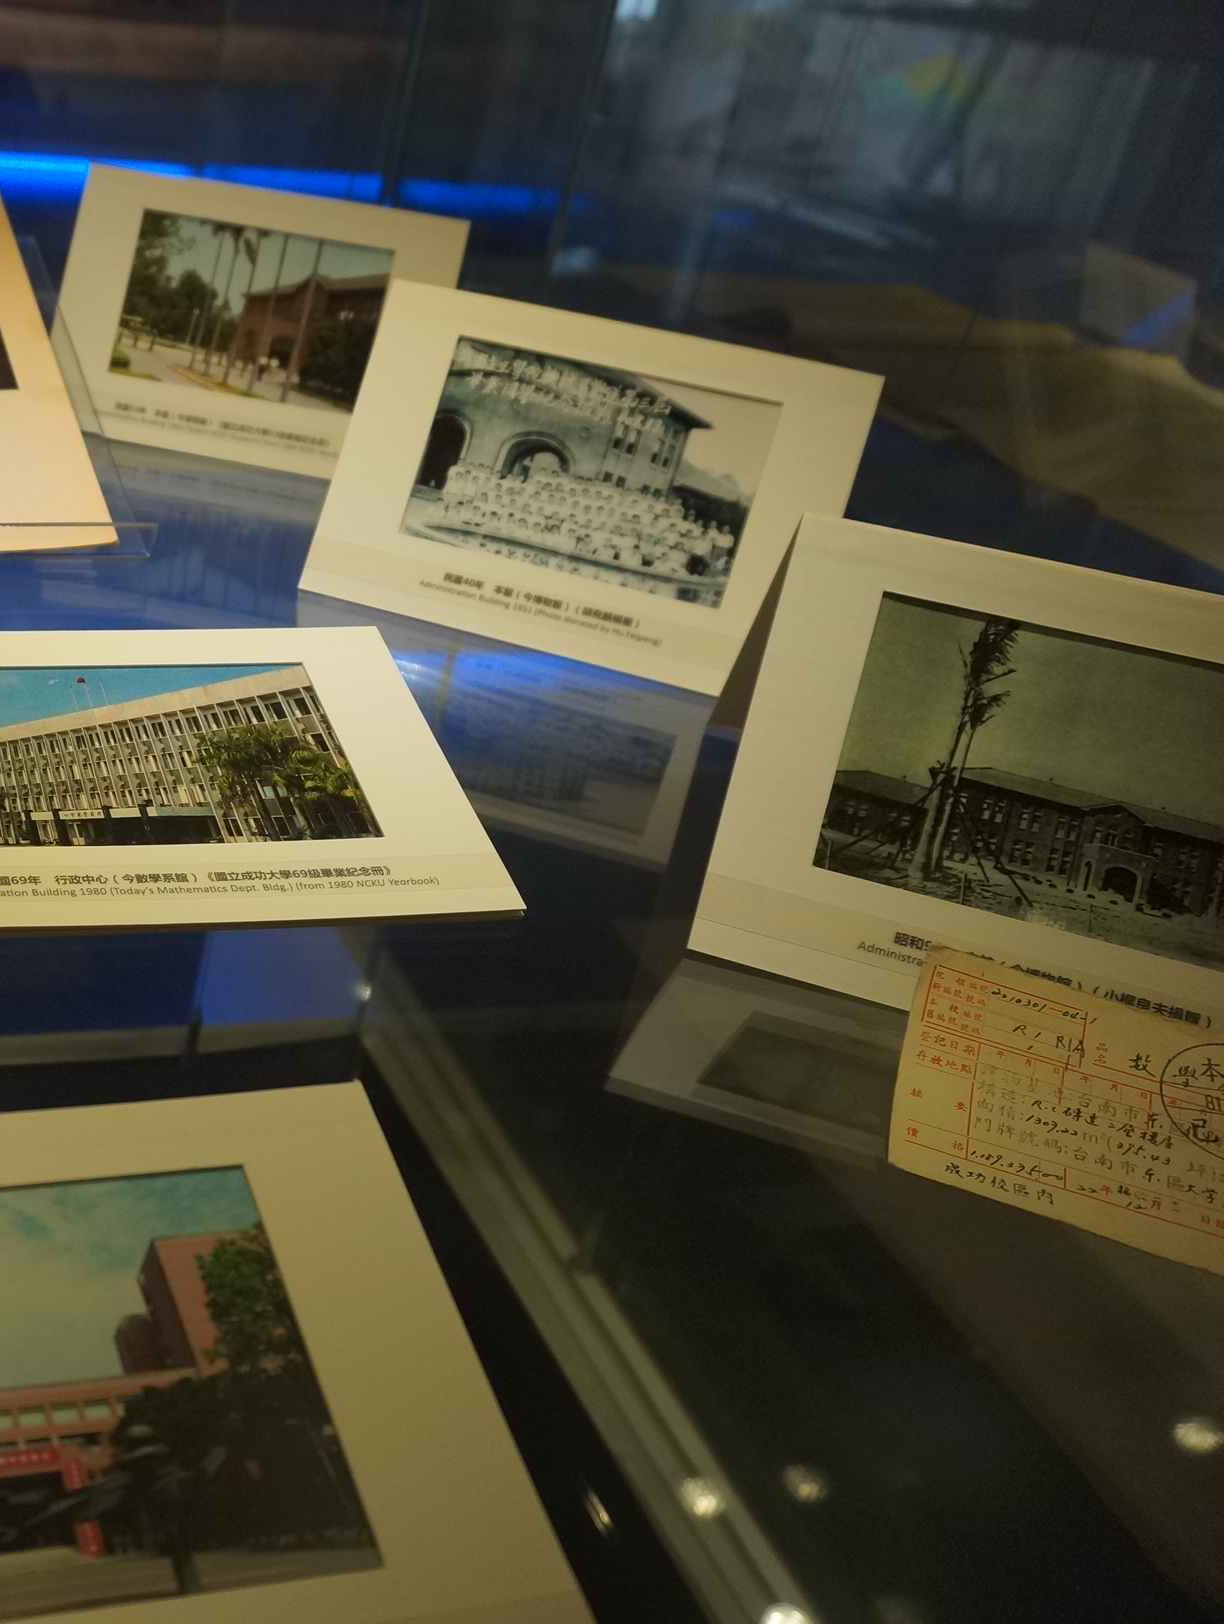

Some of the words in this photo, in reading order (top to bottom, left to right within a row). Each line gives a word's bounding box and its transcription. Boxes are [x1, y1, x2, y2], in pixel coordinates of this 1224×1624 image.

[418, 579, 477, 601] Administration
[478, 594, 510, 611] Building
[512, 602, 533, 615] 1951
[534, 606, 562, 622] (Photo
[563, 614, 598, 630] donated
[599, 622, 610, 634] by
[31, 886, 77, 898] Building
[79, 886, 108, 897] 1980
[110, 884, 155, 897] (Today's
[157, 884, 229, 896] Mathematics
[230, 883, 260, 895] Dept.
[263, 881, 294, 894] Bldg.)
[295, 880, 326, 892] (from
[327, 879, 353, 890] 1980
[355, 877, 386, 888] NCKU
[387, 874, 440, 887] Yearbook)
[53, 872, 199, 887] 行政中心（今數學系館）
[206, 865, 392, 882] 《國立成功大學69級畢業紀念冊》
[858, 939, 929, 967] Administra
